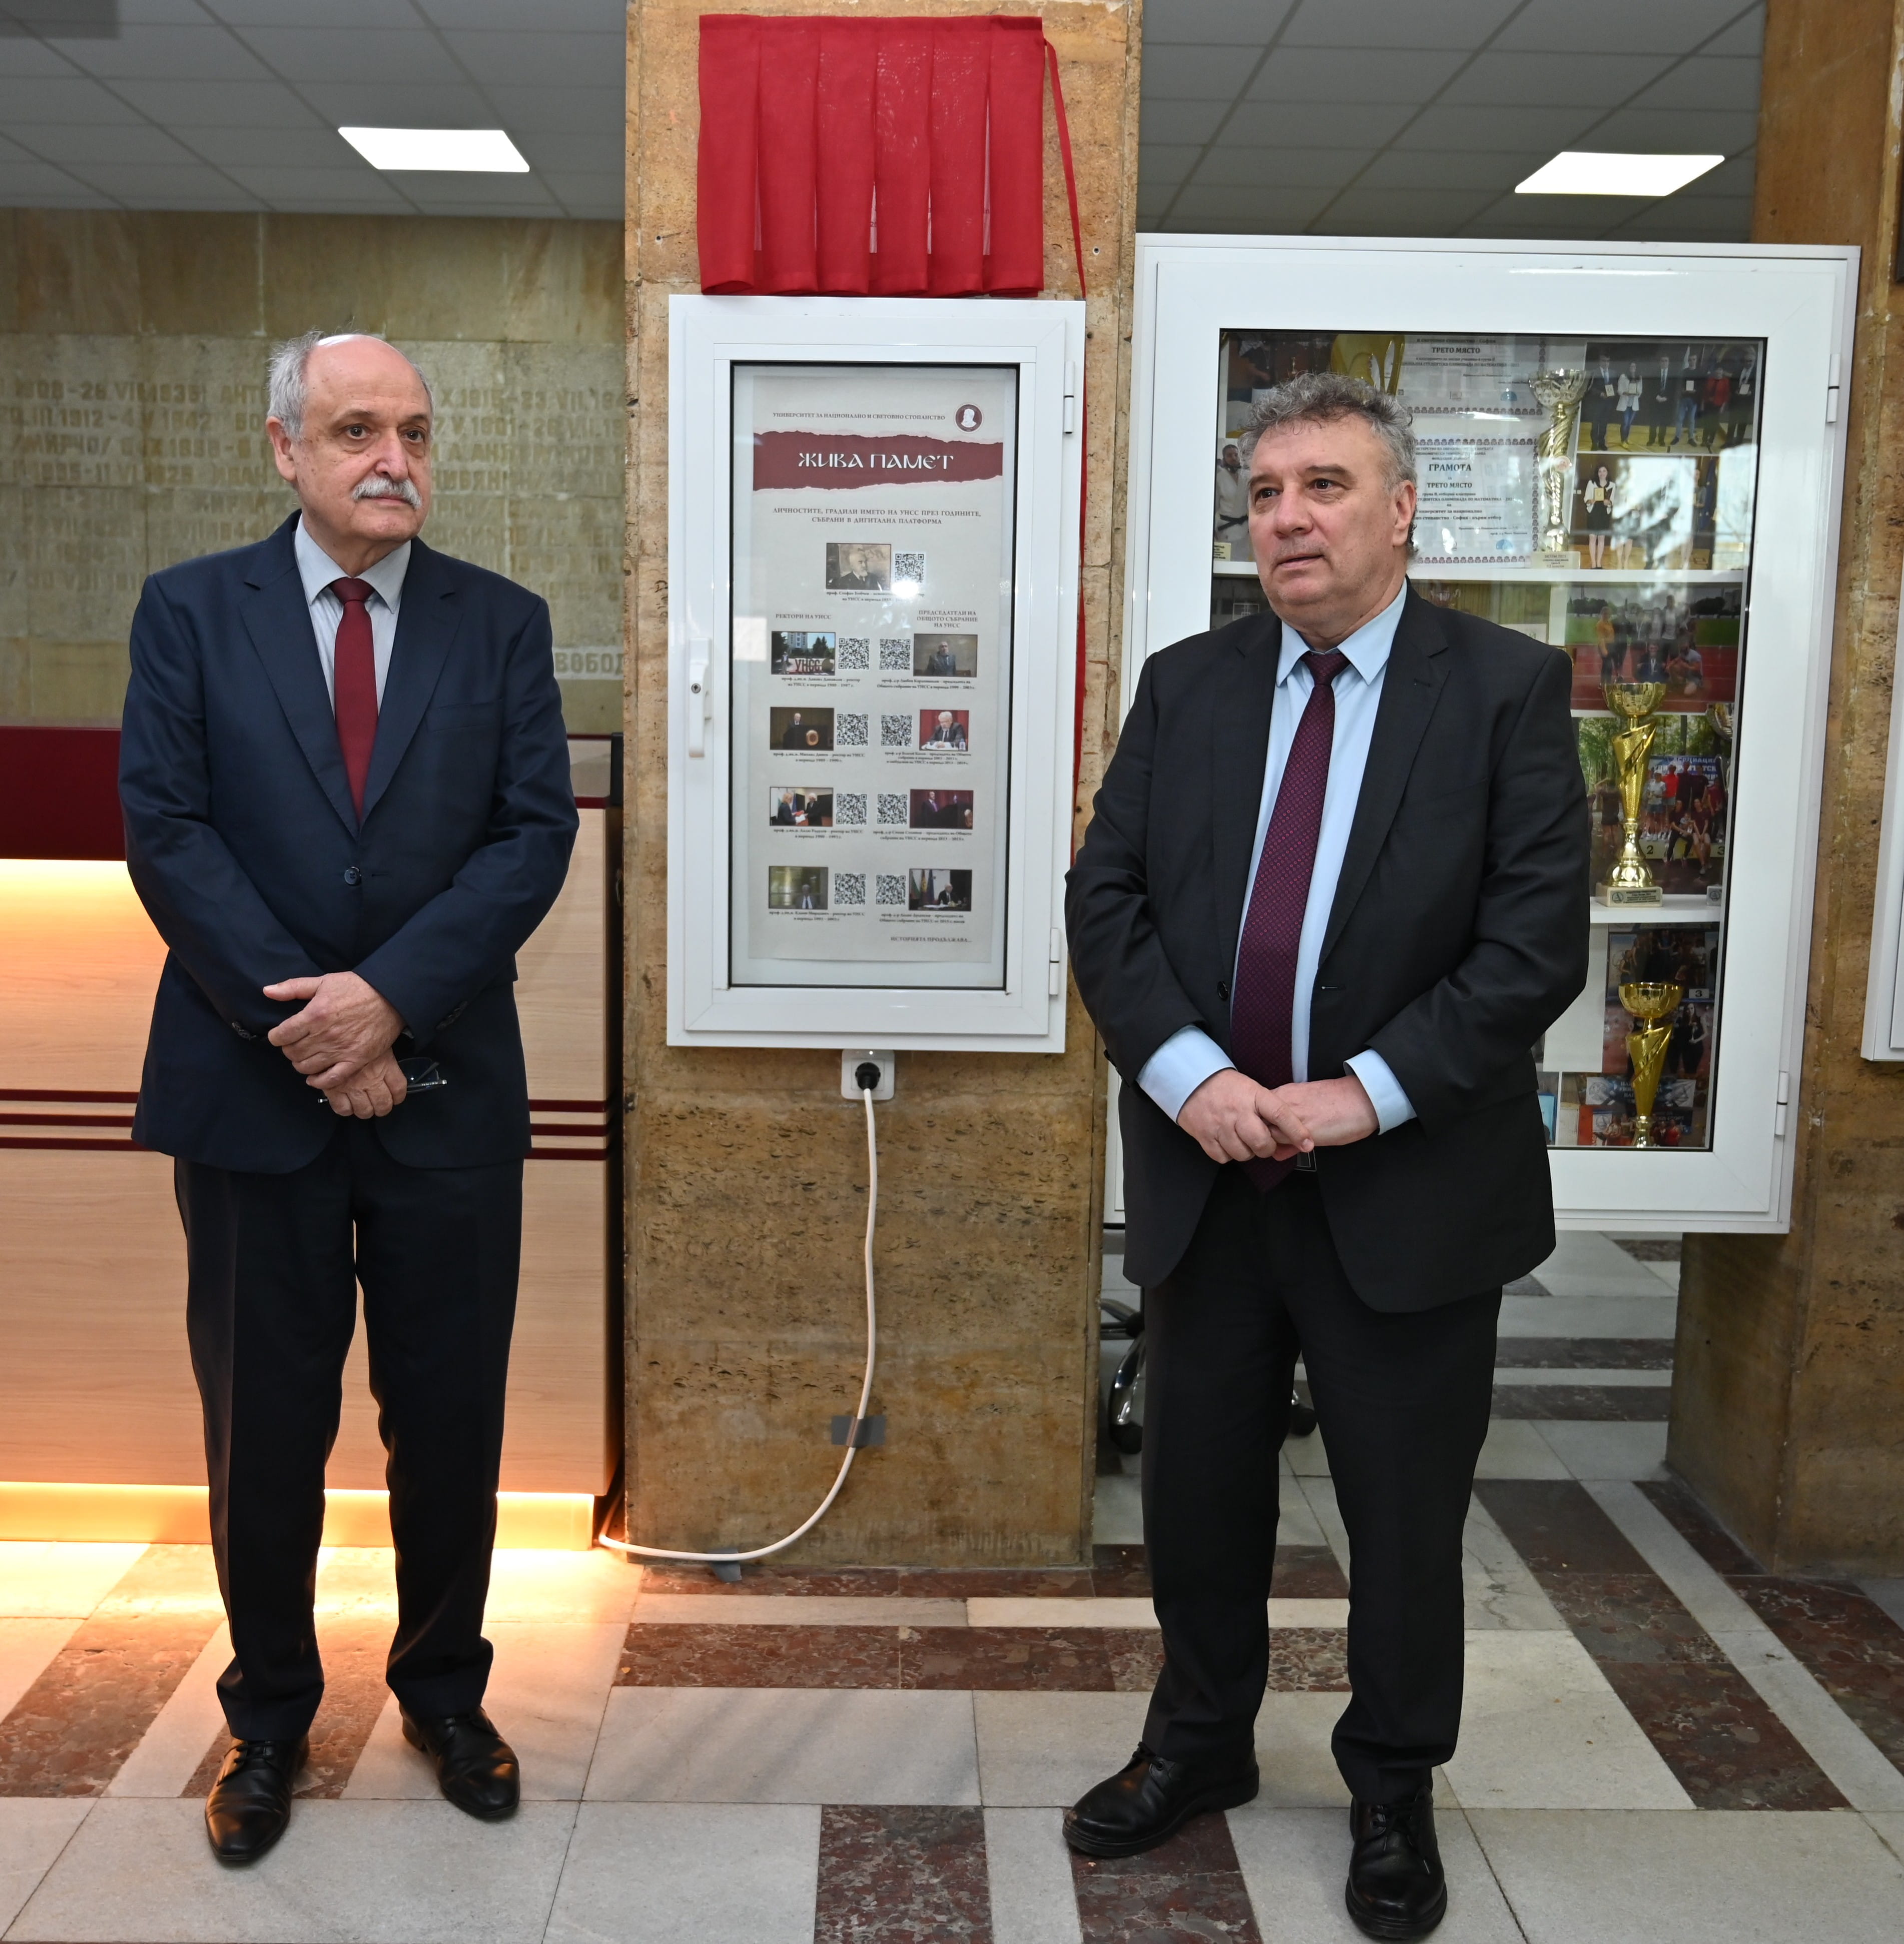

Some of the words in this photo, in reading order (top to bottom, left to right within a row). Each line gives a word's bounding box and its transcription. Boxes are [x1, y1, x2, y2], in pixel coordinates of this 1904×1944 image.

[798, 452, 863, 468] ЖИВА
[870, 454, 954, 470] ПАМЕТ
[1429, 464, 1472, 472] ГРАМОТА
[795, 659, 821, 672] УНСС
[1646, 845, 1654, 855] 2
